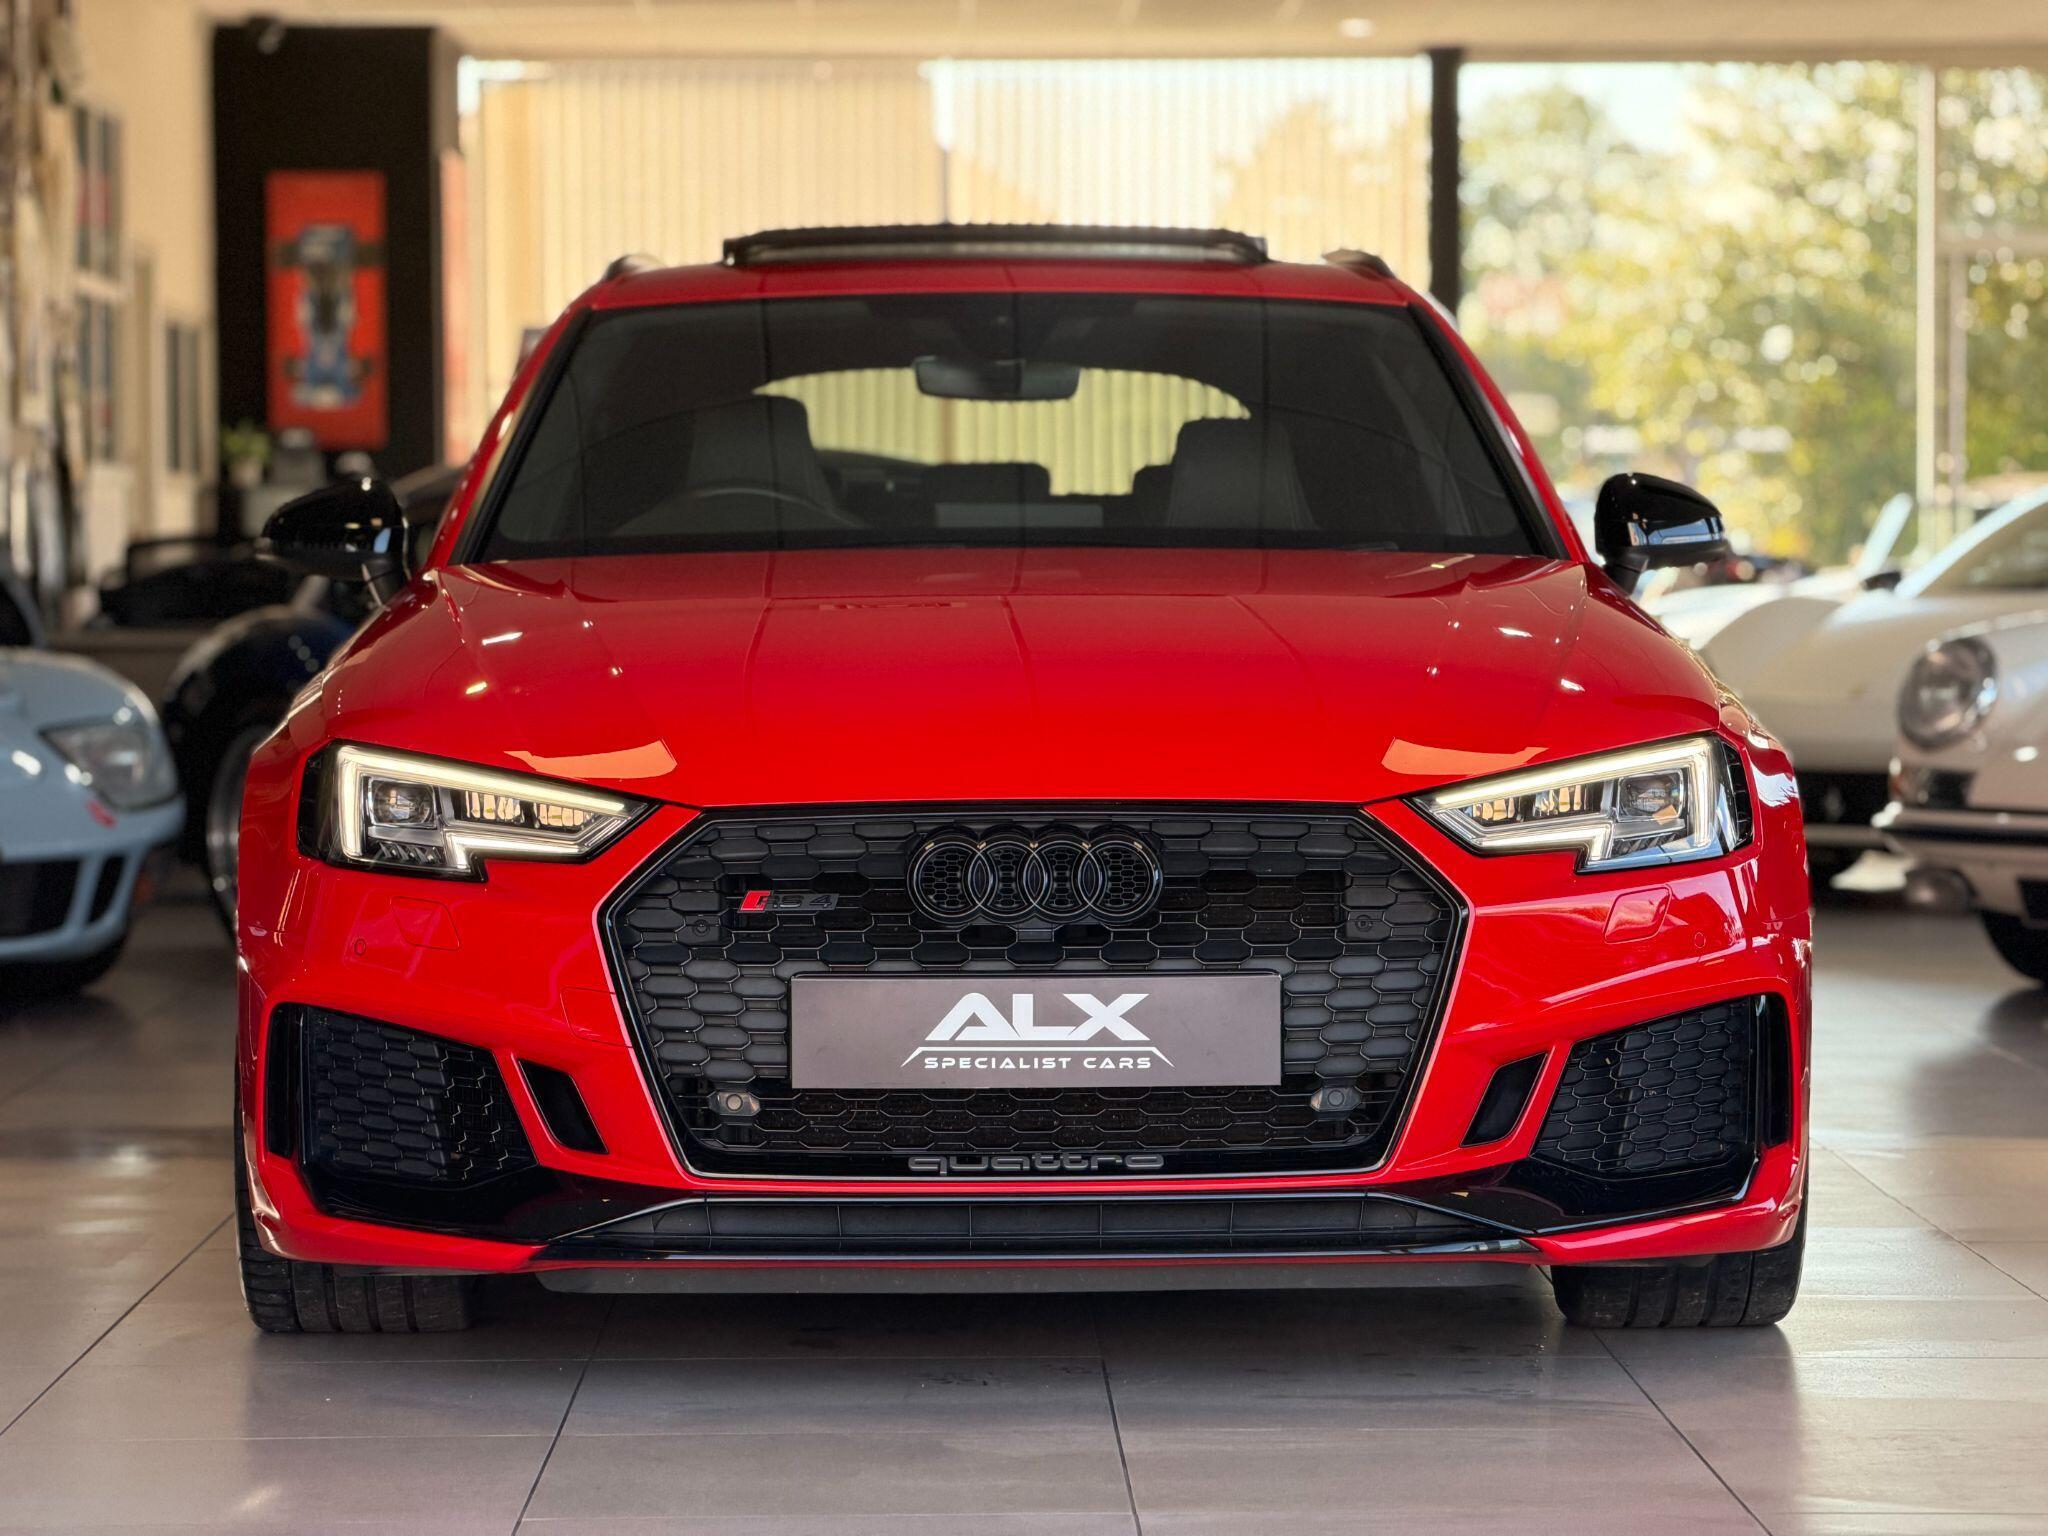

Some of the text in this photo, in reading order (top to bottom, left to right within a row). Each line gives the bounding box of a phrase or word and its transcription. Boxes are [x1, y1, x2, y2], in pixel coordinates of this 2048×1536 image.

[924, 992, 1151, 1041] ALX
[924, 1056, 1152, 1070] SPECIALIST CARS
[907, 1152, 1165, 1176] quattro
